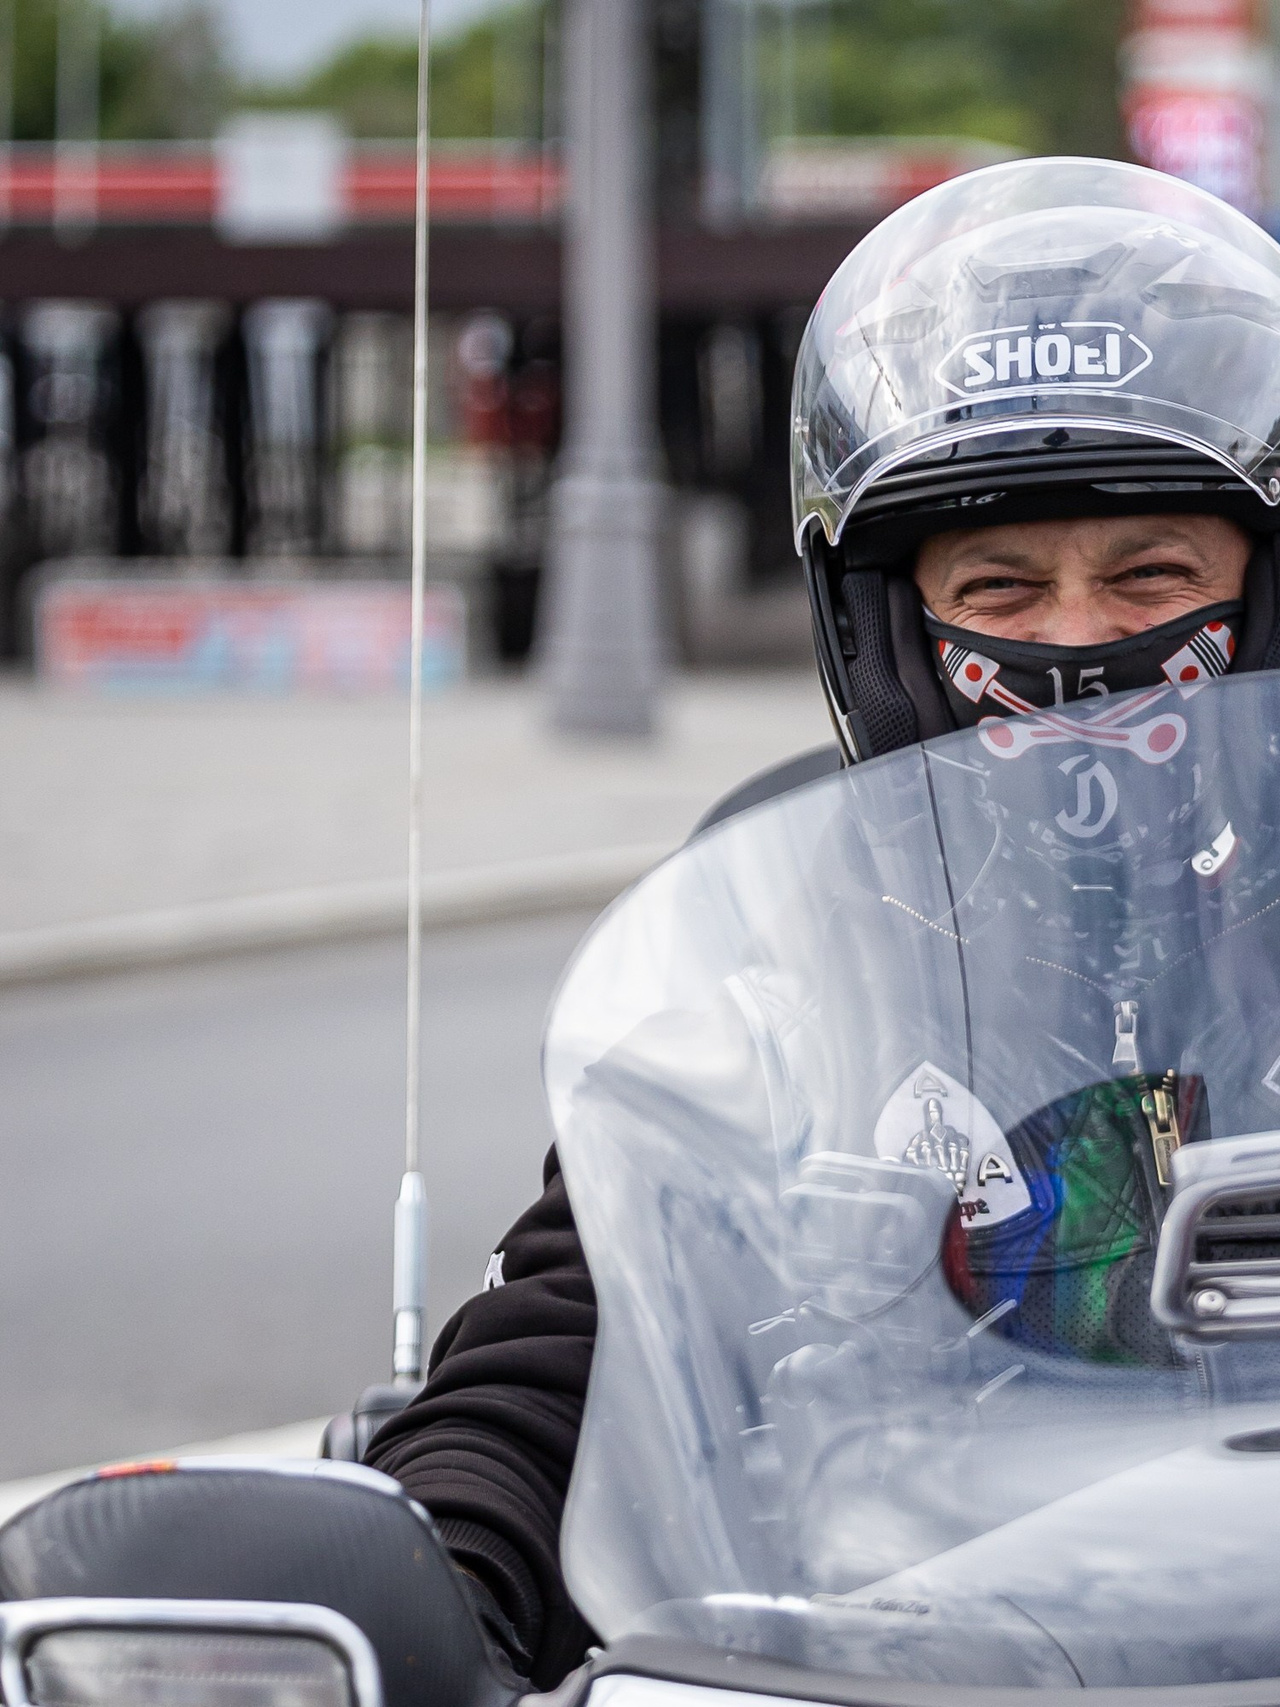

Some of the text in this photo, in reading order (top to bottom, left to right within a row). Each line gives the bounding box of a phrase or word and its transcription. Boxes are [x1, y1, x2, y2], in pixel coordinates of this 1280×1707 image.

[963, 333, 1121, 388] SHOEI
[1046, 666, 1109, 711] 15
[977, 1152, 1014, 1187] A
